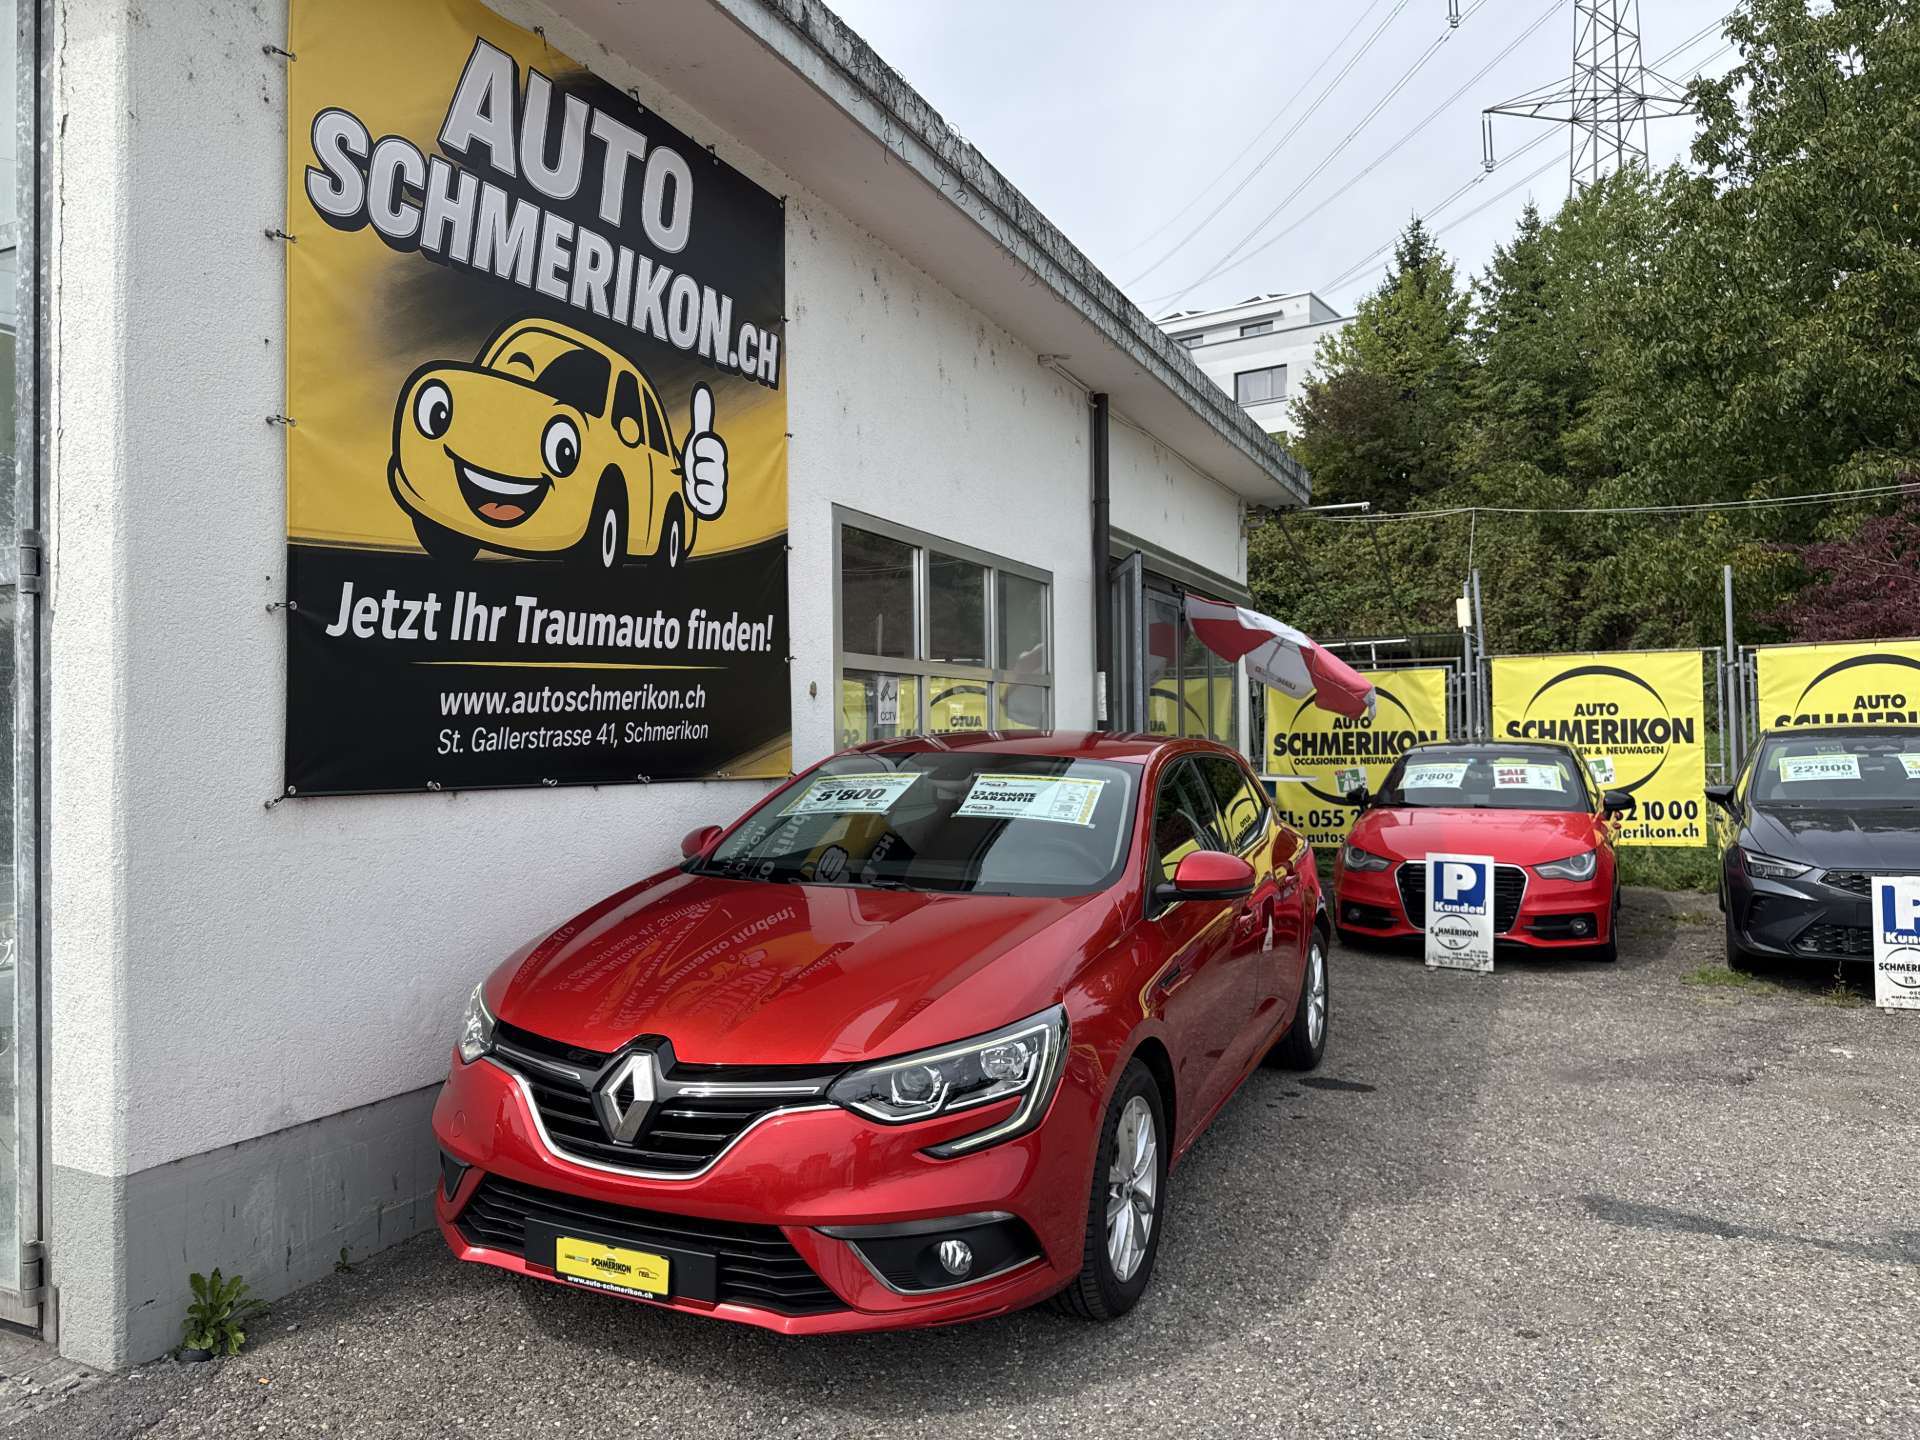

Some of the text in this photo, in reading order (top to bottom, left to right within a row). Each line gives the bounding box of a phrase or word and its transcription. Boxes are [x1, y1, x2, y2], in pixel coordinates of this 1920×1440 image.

[441, 37, 694, 254] AUTO
[307, 109, 780, 384] SCHMERIKON.CH
[325, 581, 773, 652] Jetzt Ihr Traumauto finden!
[440, 683, 706, 716] www.autoschmerikon.ch
[1854, 694, 1906, 709] AUTO
[1574, 703, 1619, 717] AUTO
[1332, 717, 1372, 730] AUTO
[1506, 717, 1694, 745] SCHMERIKON
[437, 720, 709, 755] St. Gallerstrasse 41, Schmerikon
[1594, 746, 1602, 755] &
[1606, 745, 1664, 755] NEUWAGEN
[1294, 756, 1347, 766] OCCASIONEN
[1350, 757, 1357, 765] &
[815, 788, 888, 802] 5'800
[1308, 809, 1345, 828] 055
[1442, 863, 1477, 900] P
[1434, 900, 1485, 915] Kunden
[1885, 931, 1920, 945] Kun
[591, 1257, 632, 1274] SCHMERIKON
[567, 1275, 653, 1299] www.auto-schmerikon.ch
